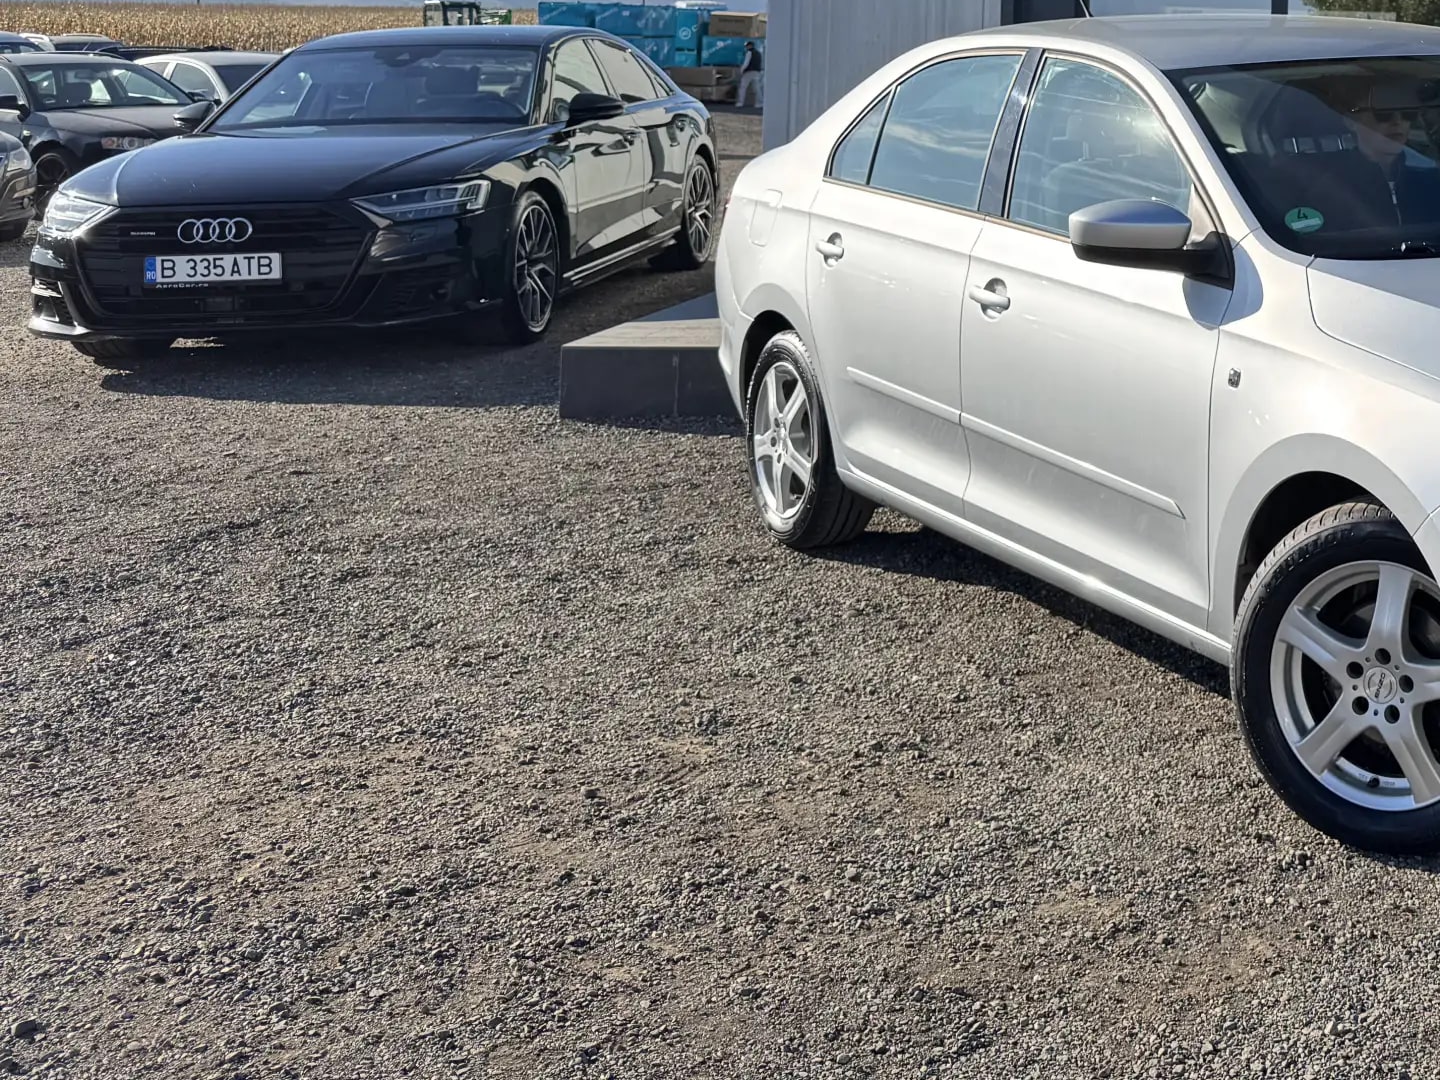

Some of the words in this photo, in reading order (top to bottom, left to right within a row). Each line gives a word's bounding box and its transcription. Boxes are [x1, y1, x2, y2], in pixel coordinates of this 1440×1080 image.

[160, 258, 176, 278] B
[186, 257, 226, 278] 335
[230, 255, 273, 277] ATB
[146, 271, 156, 280] RO
